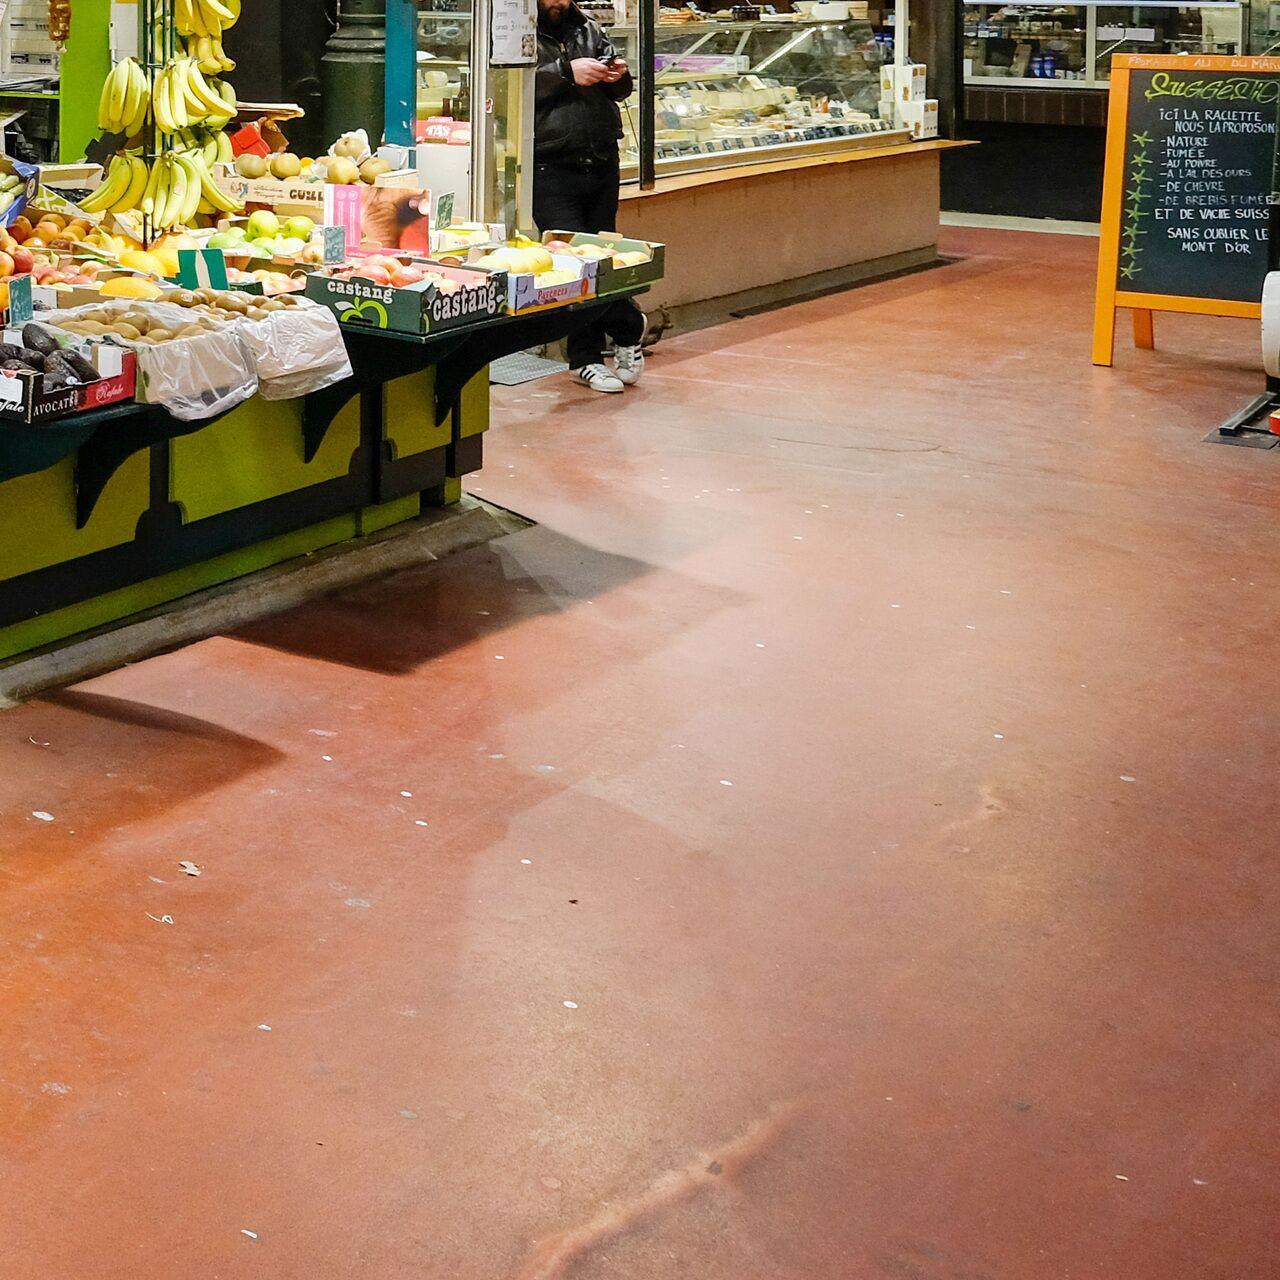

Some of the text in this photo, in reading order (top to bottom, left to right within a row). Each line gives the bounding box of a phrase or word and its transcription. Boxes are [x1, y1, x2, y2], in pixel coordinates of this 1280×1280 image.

[1194, 58, 1211, 67] AU
[1184, 109, 1199, 120] LA
[1205, 109, 1262, 122] RACLETTE
[1175, 122, 1276, 134] NOUS LA PROPOSON
[1185, 159, 1218, 168] POIVRE
[1202, 169, 1223, 178] DES
[1224, 169, 1252, 178] OURS
[1185, 195, 1227, 205] BREBIS
[1154, 208, 1174, 220] ET
[1180, 208, 1195, 220] DE
[1235, 208, 1270, 219] SUISS
[1167, 227, 1270, 241] SANS OUBLIER LE
[1181, 241, 1252, 254] MONT D'OR
[327, 279, 394, 304] castang
[433, 281, 497, 321] castang
[95, 381, 124, 403] Rafale
